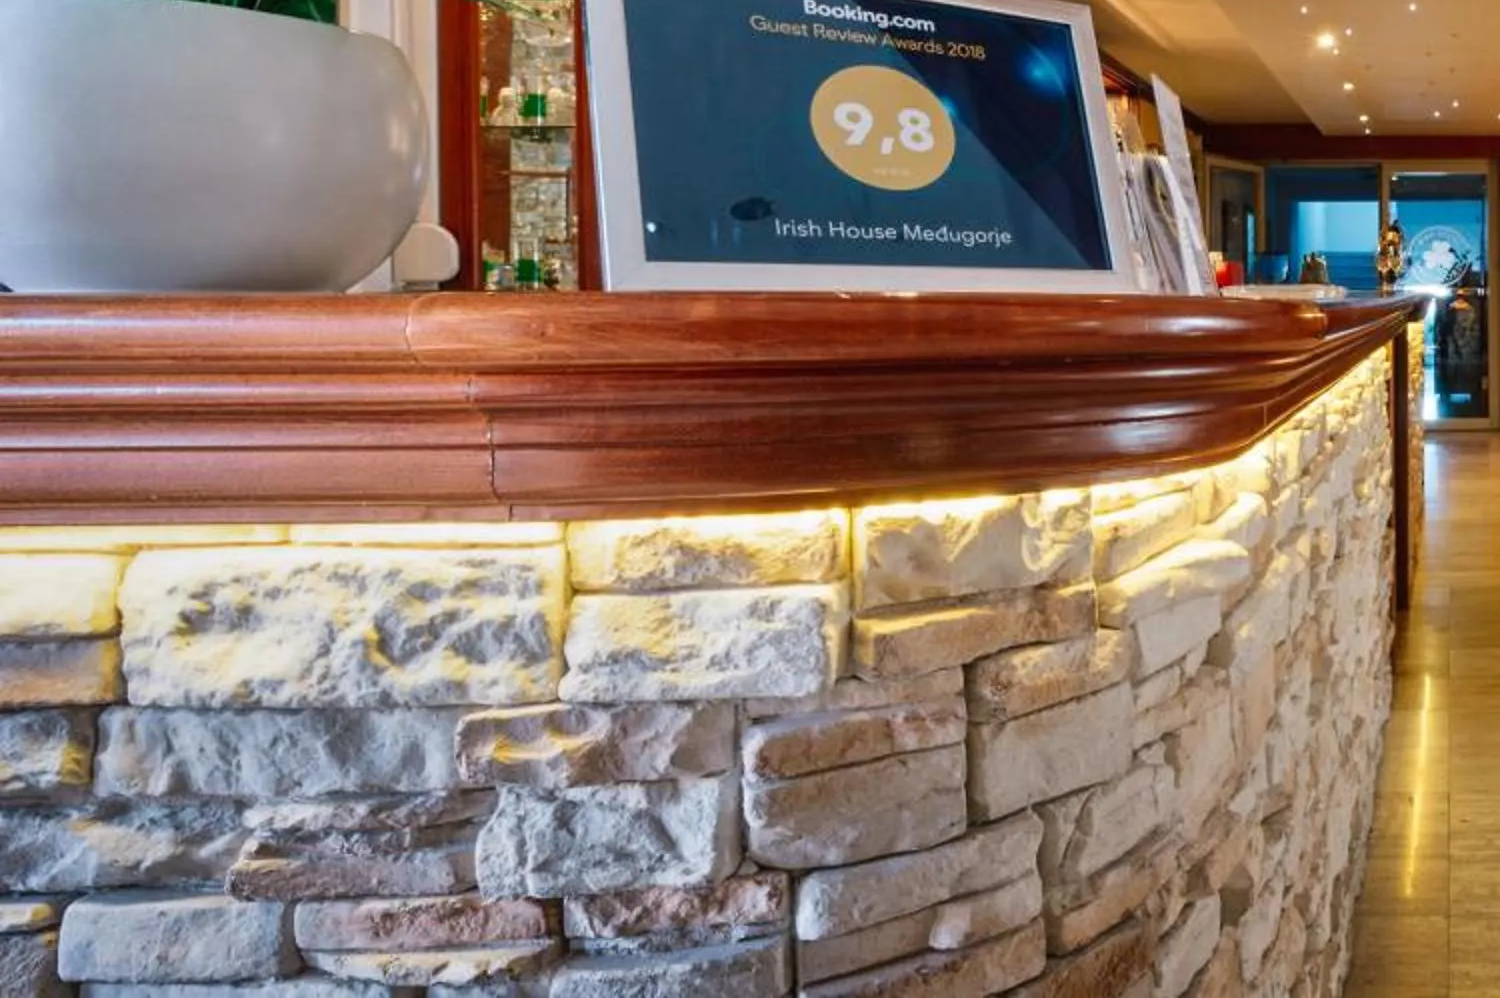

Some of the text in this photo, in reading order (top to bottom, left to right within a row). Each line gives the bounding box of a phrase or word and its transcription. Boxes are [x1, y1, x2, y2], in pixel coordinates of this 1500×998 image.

[749, 15, 986, 62] Guest Review Awards 2018
[833, 101, 934, 155] 9,8
[774, 217, 823, 238] Irish
[828, 220, 897, 240] House
